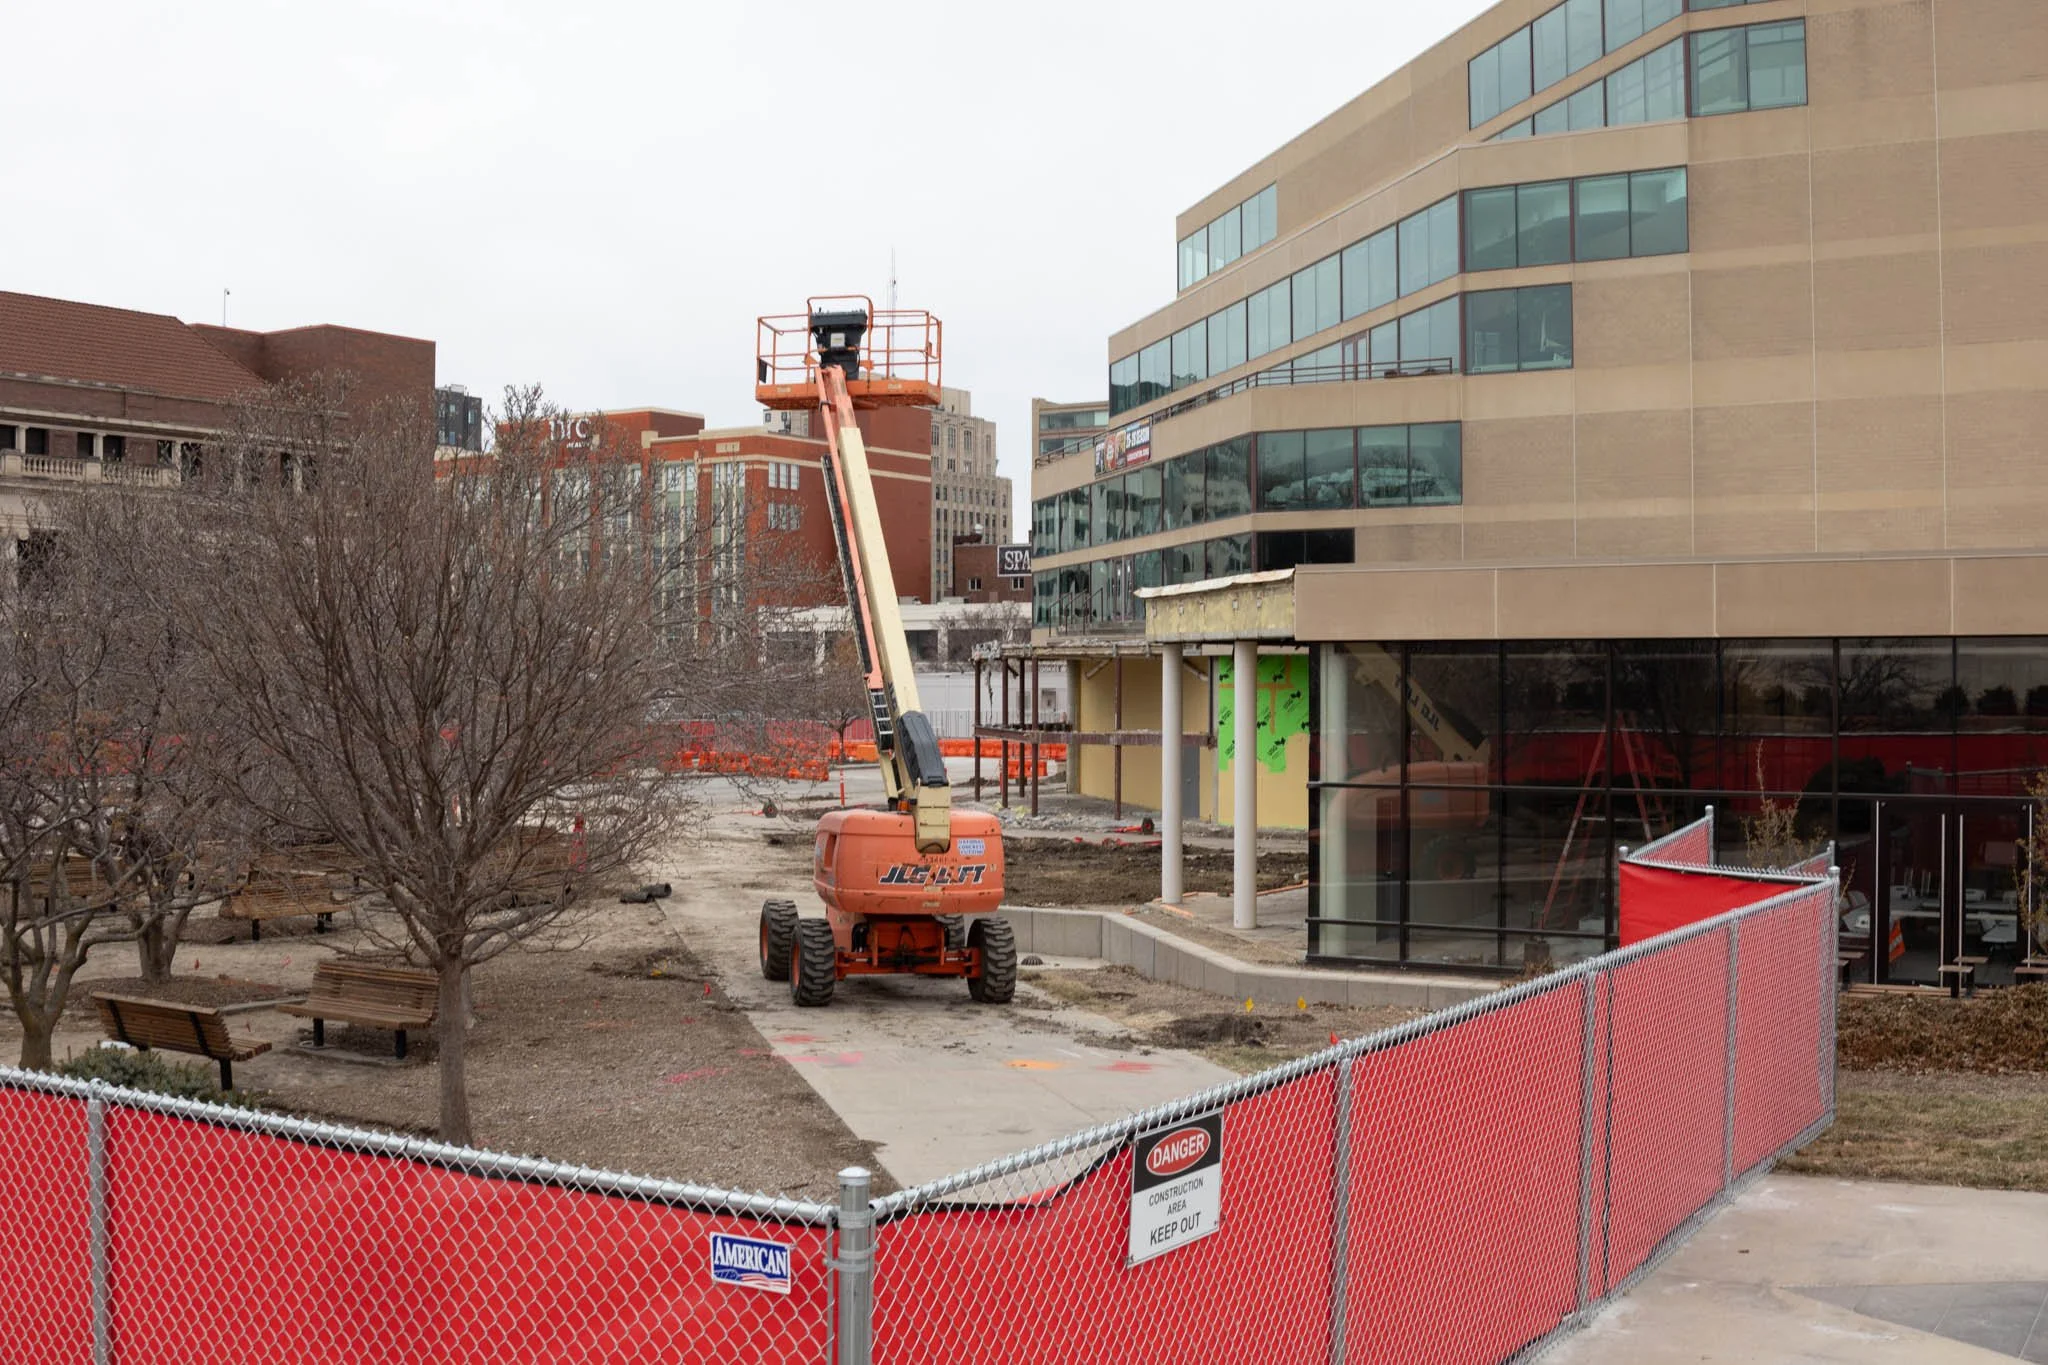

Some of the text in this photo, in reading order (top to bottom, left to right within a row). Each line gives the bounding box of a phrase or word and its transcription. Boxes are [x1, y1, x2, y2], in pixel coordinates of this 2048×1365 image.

[934, 864, 986, 885] LFT
[1152, 1132, 1205, 1169] DANGER
[1149, 1176, 1204, 1206] CONSTRUCTION
[1167, 1199, 1187, 1216] AREA
[1150, 1212, 1201, 1246] KEEP OUT
[714, 1237, 787, 1276] AMERICAN
